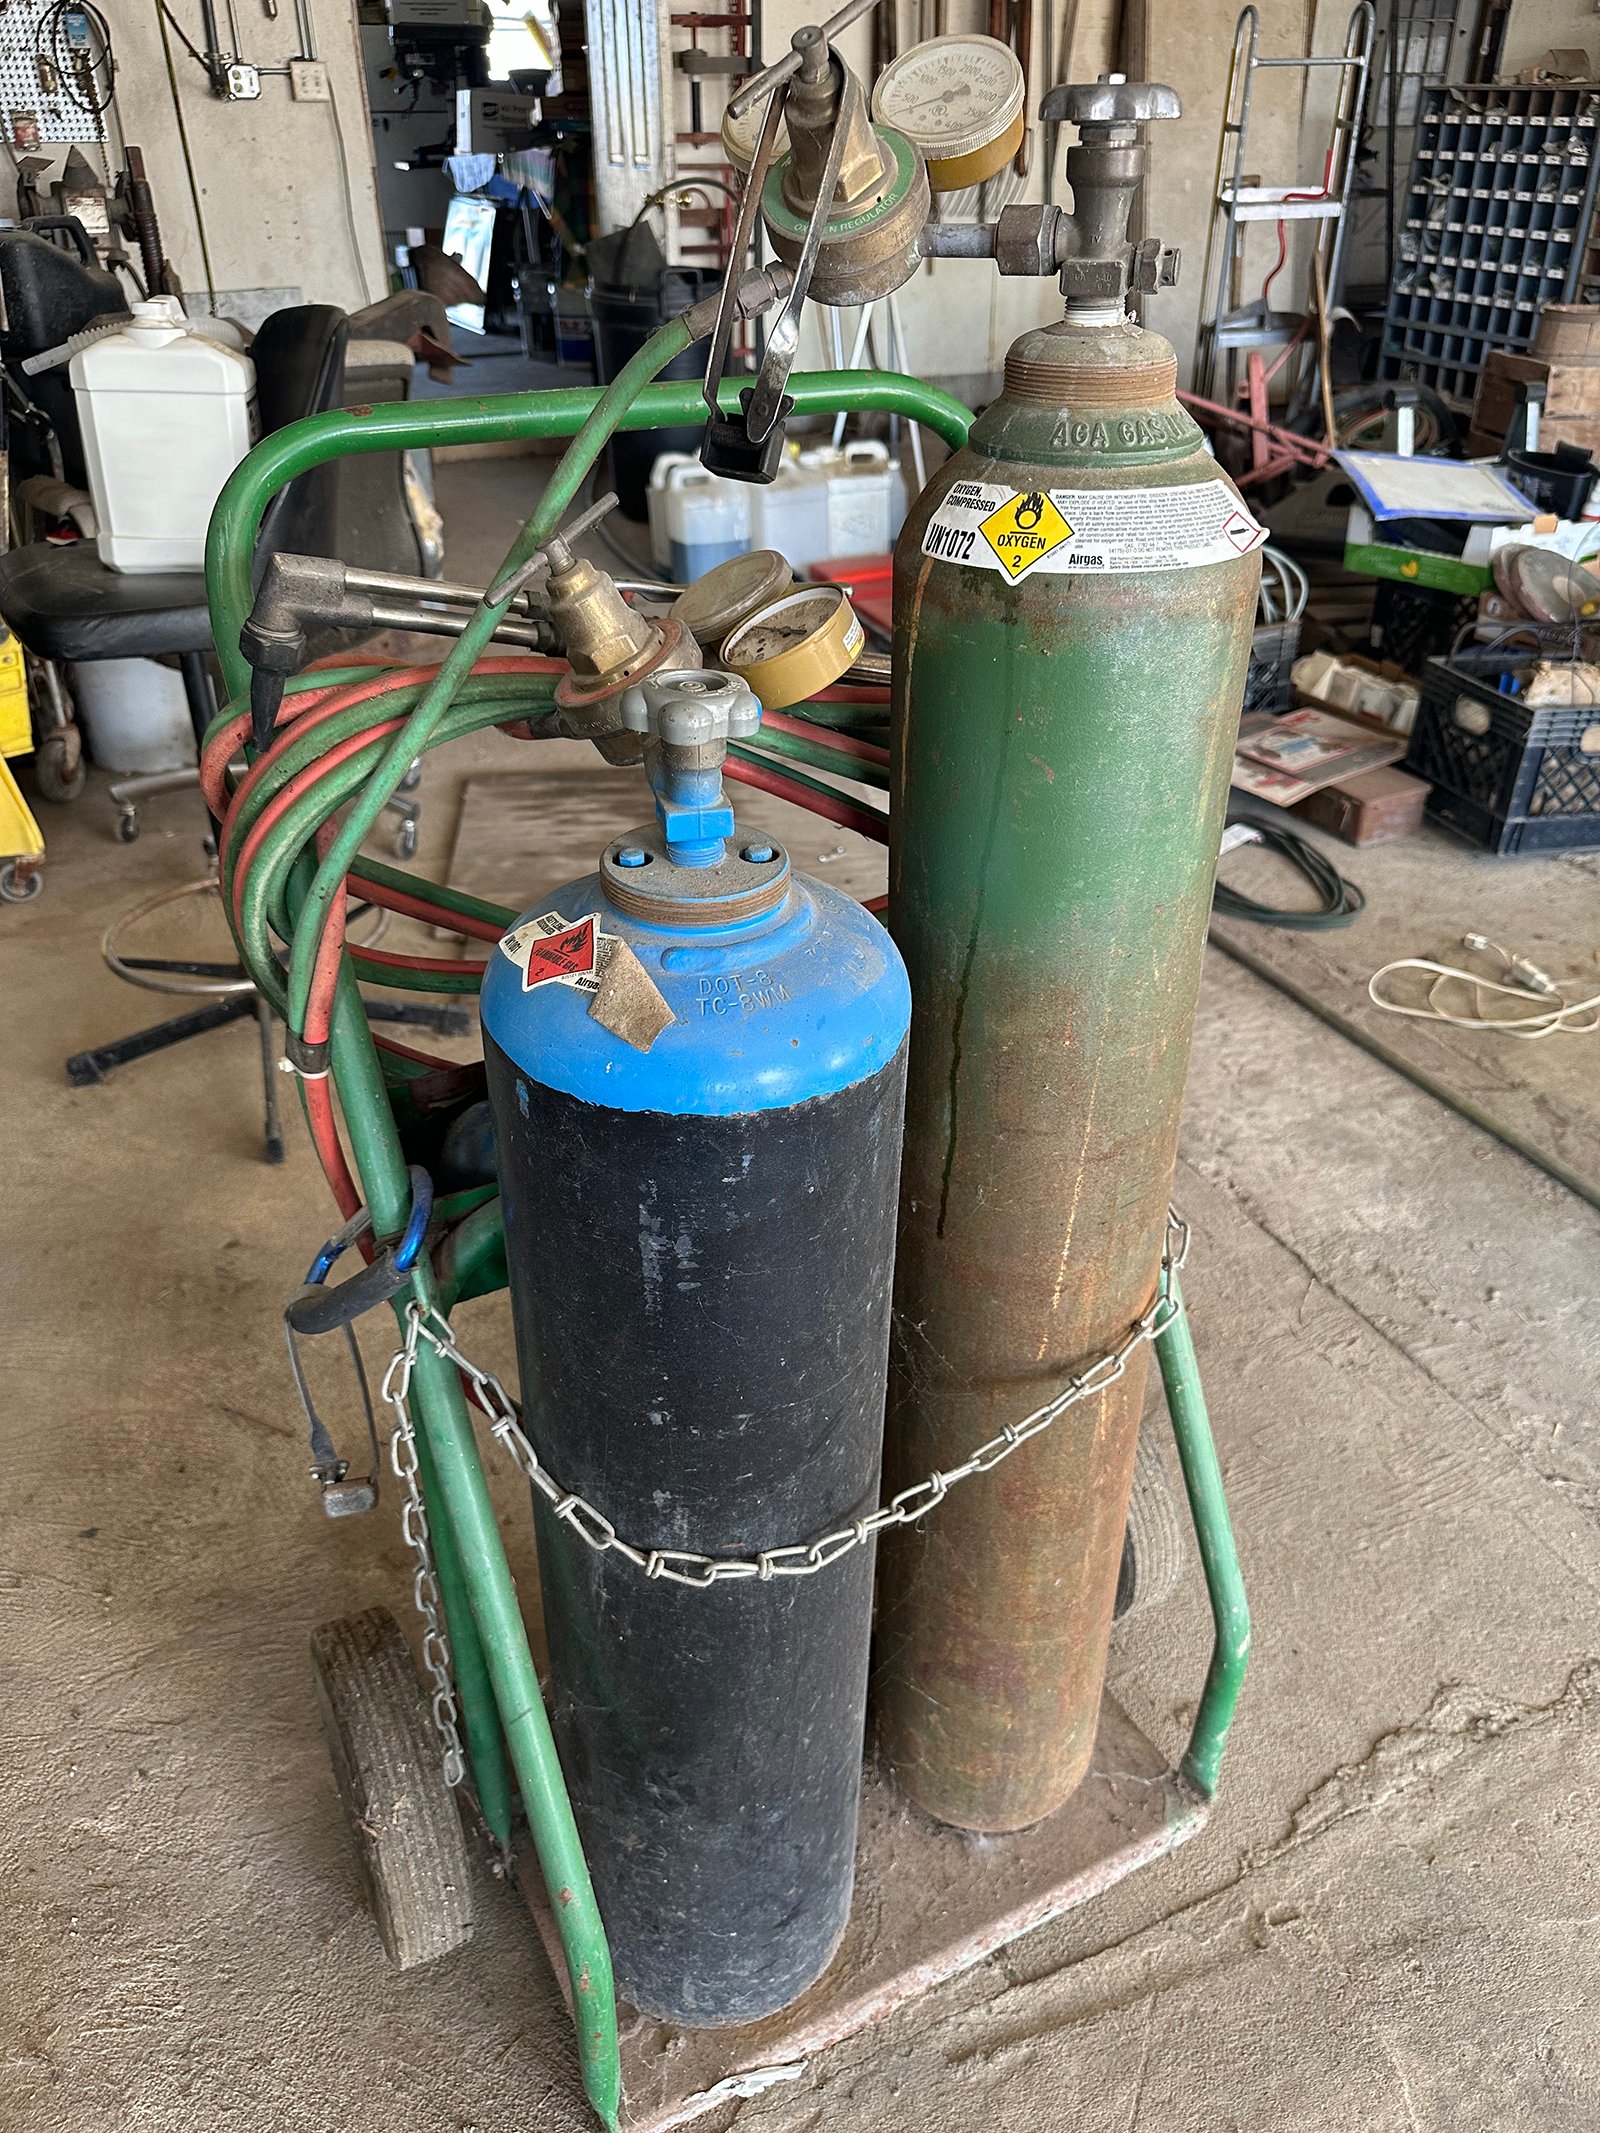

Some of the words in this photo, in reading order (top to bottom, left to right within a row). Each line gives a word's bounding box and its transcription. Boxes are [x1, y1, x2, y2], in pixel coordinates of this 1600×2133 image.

[937, 64, 956, 77] 1500
[960, 64, 982, 77] 2000
[919, 73, 938, 86] 1000
[975, 73, 997, 87] 2500
[902, 93, 919, 104] 500
[975, 89, 998, 102] 3000
[840, 193, 899, 231] REGULATOR
[1117, 417, 1167, 447] GAS
[952, 483, 983, 498] OXYGEN,
[946, 494, 996, 513] COMPRESSED
[925, 523, 976, 560] UN1072
[997, 534, 1047, 550] OXYGEN
[1011, 555, 1022, 568] 2
[1069, 553, 1103, 567] Airgas
[533, 947, 568, 967] FLAMMABLE
[562, 960, 579, 972] GAS
[534, 967, 545, 977] 2
[575, 976, 600, 991] Airga
[699, 969, 773, 996] DOT-8
[695, 984, 791, 1017] TC-8WM
